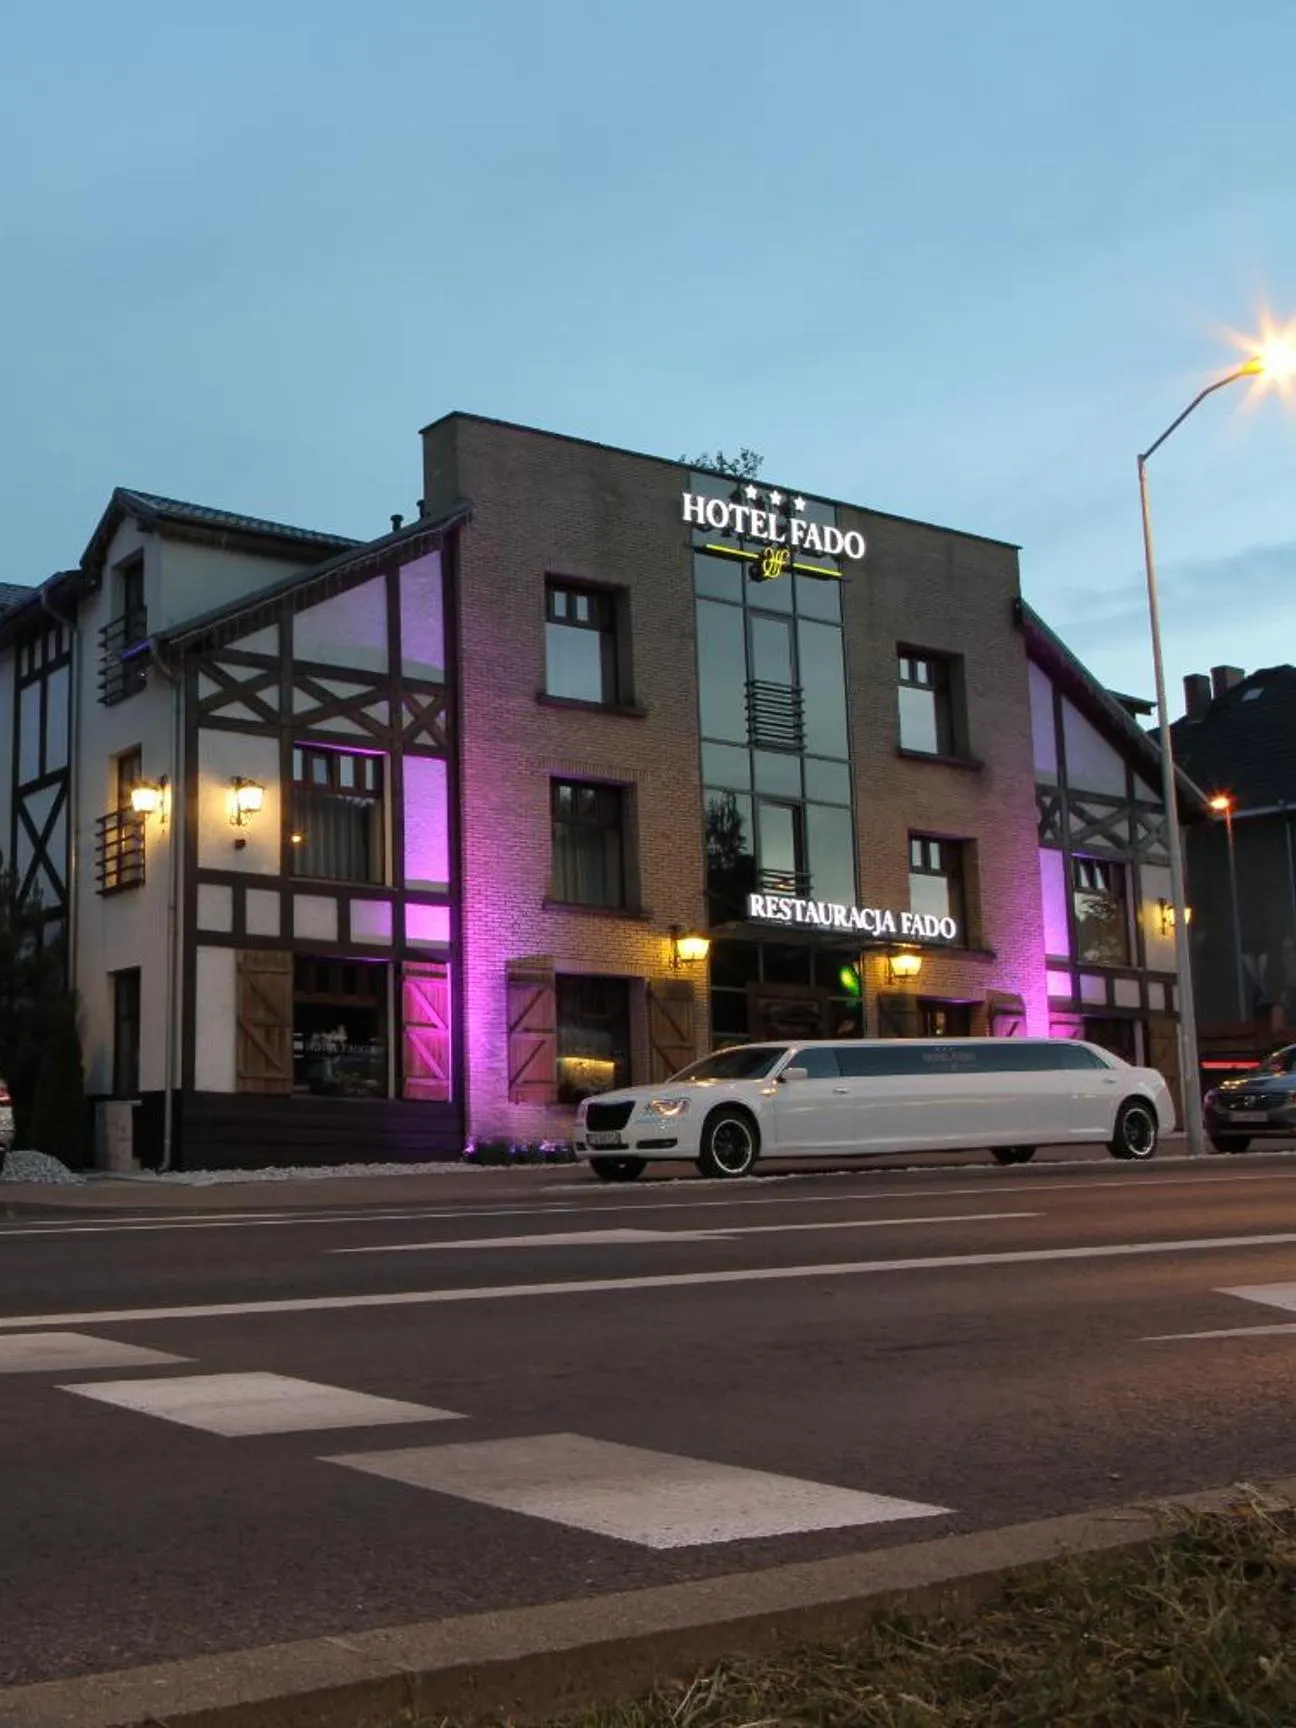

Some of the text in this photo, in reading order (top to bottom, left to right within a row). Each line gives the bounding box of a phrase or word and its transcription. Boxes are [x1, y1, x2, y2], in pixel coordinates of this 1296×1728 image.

[682, 491, 867, 560] HOTEL FADO
[749, 893, 957, 939] RESTAURACJA FADO
